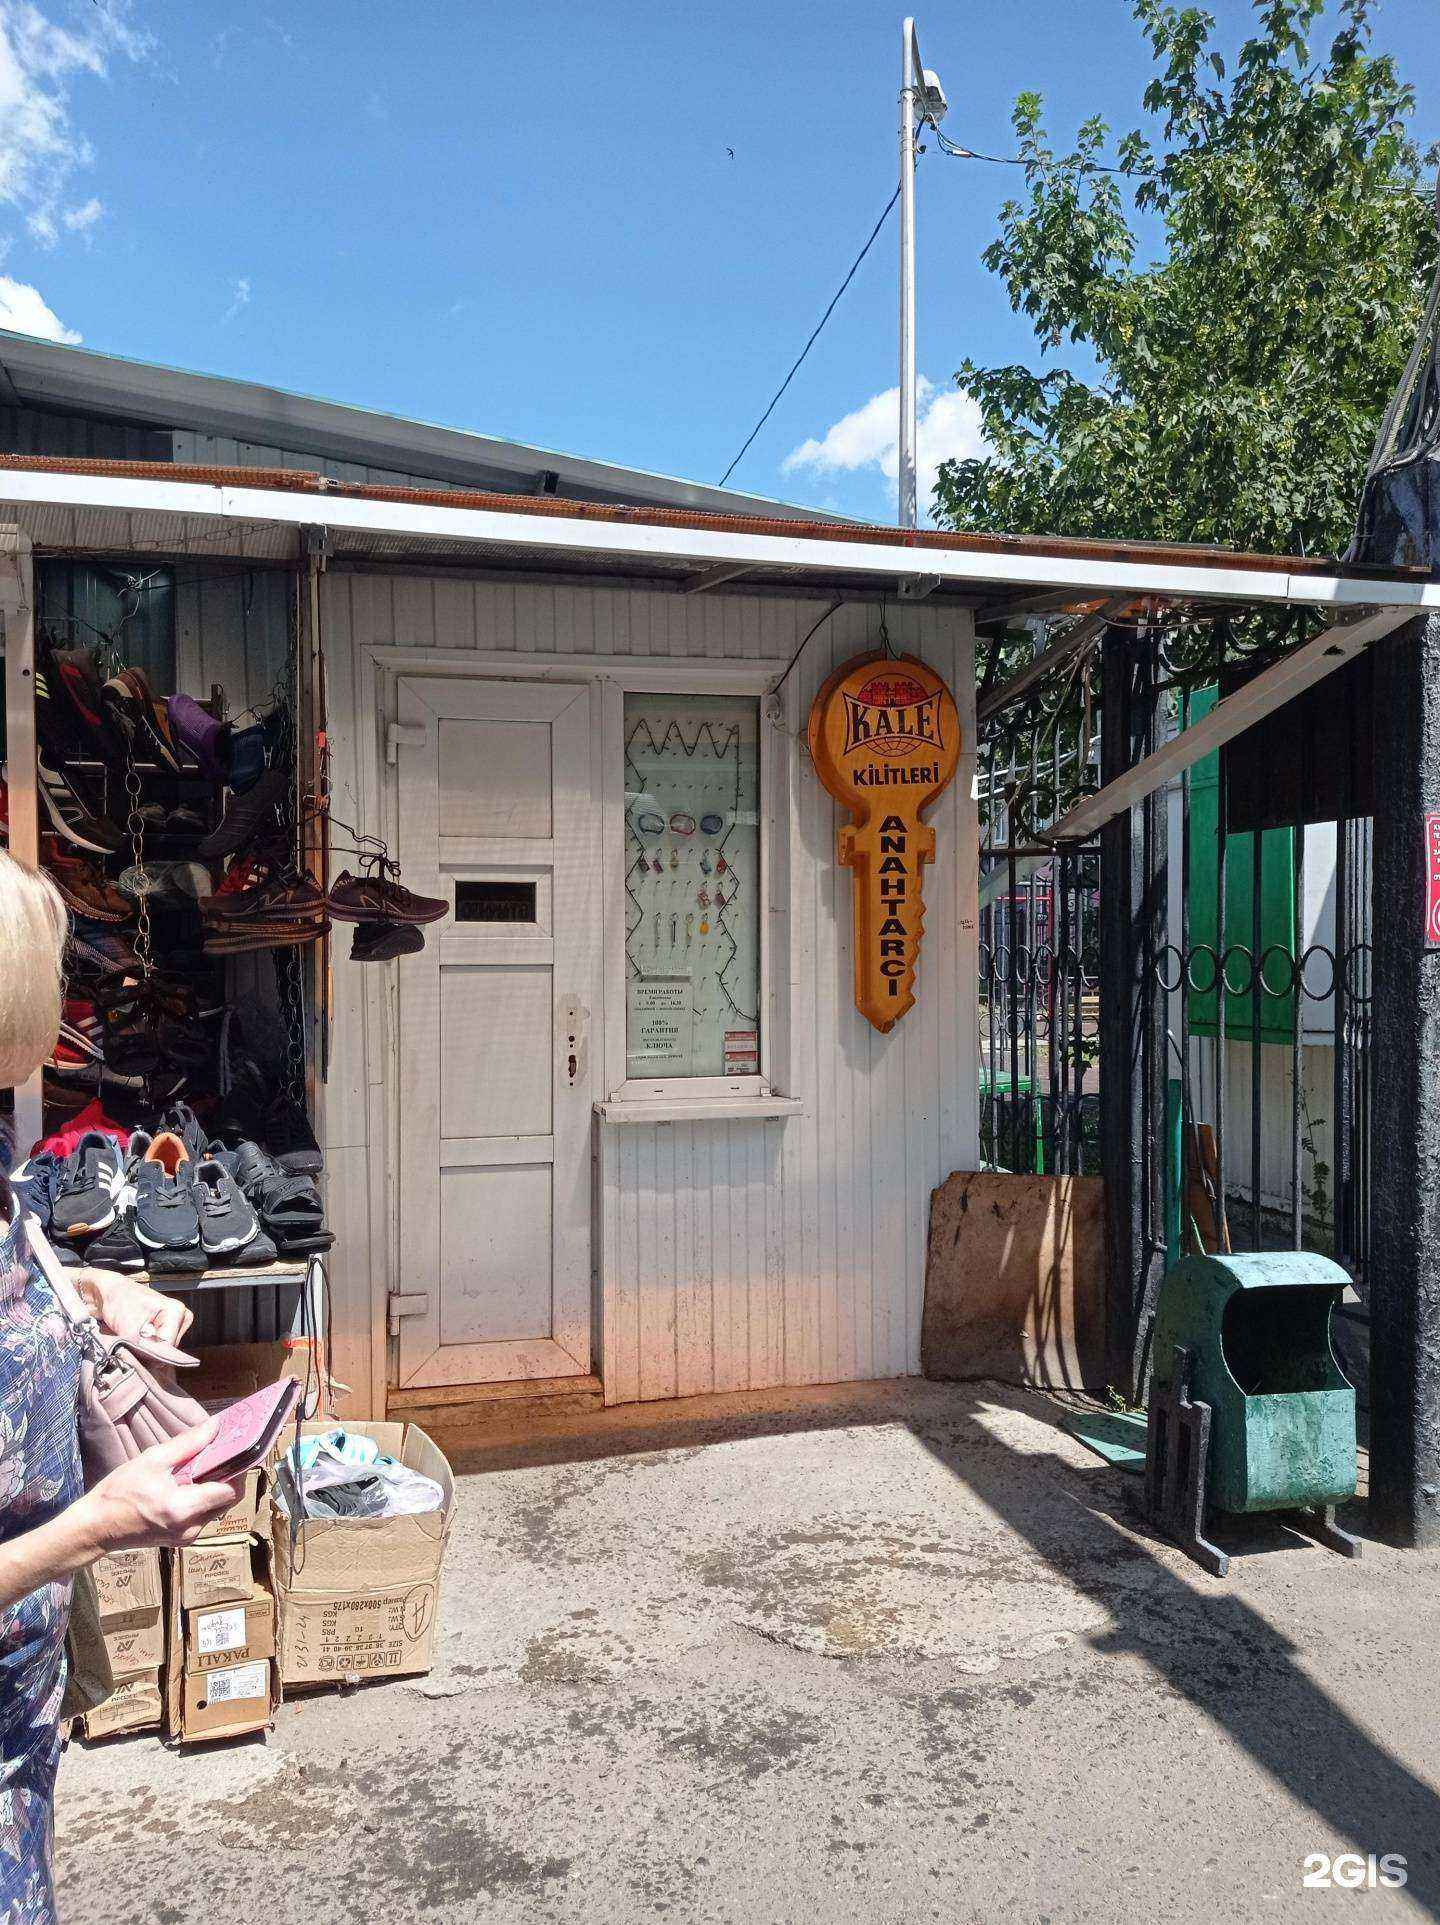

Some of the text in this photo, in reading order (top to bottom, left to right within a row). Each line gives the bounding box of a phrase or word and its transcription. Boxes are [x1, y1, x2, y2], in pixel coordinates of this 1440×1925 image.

[851, 701, 934, 745] KALE
[853, 761, 940, 786] KİLİTLERİ
[878, 815, 908, 997] ANAHTARCI
[322, 1619, 337, 1627] KGS
[323, 1610, 338, 1618] KGS
[388, 1639, 403, 1648] SIZE
[197, 1647, 250, 1668] PAKALI
